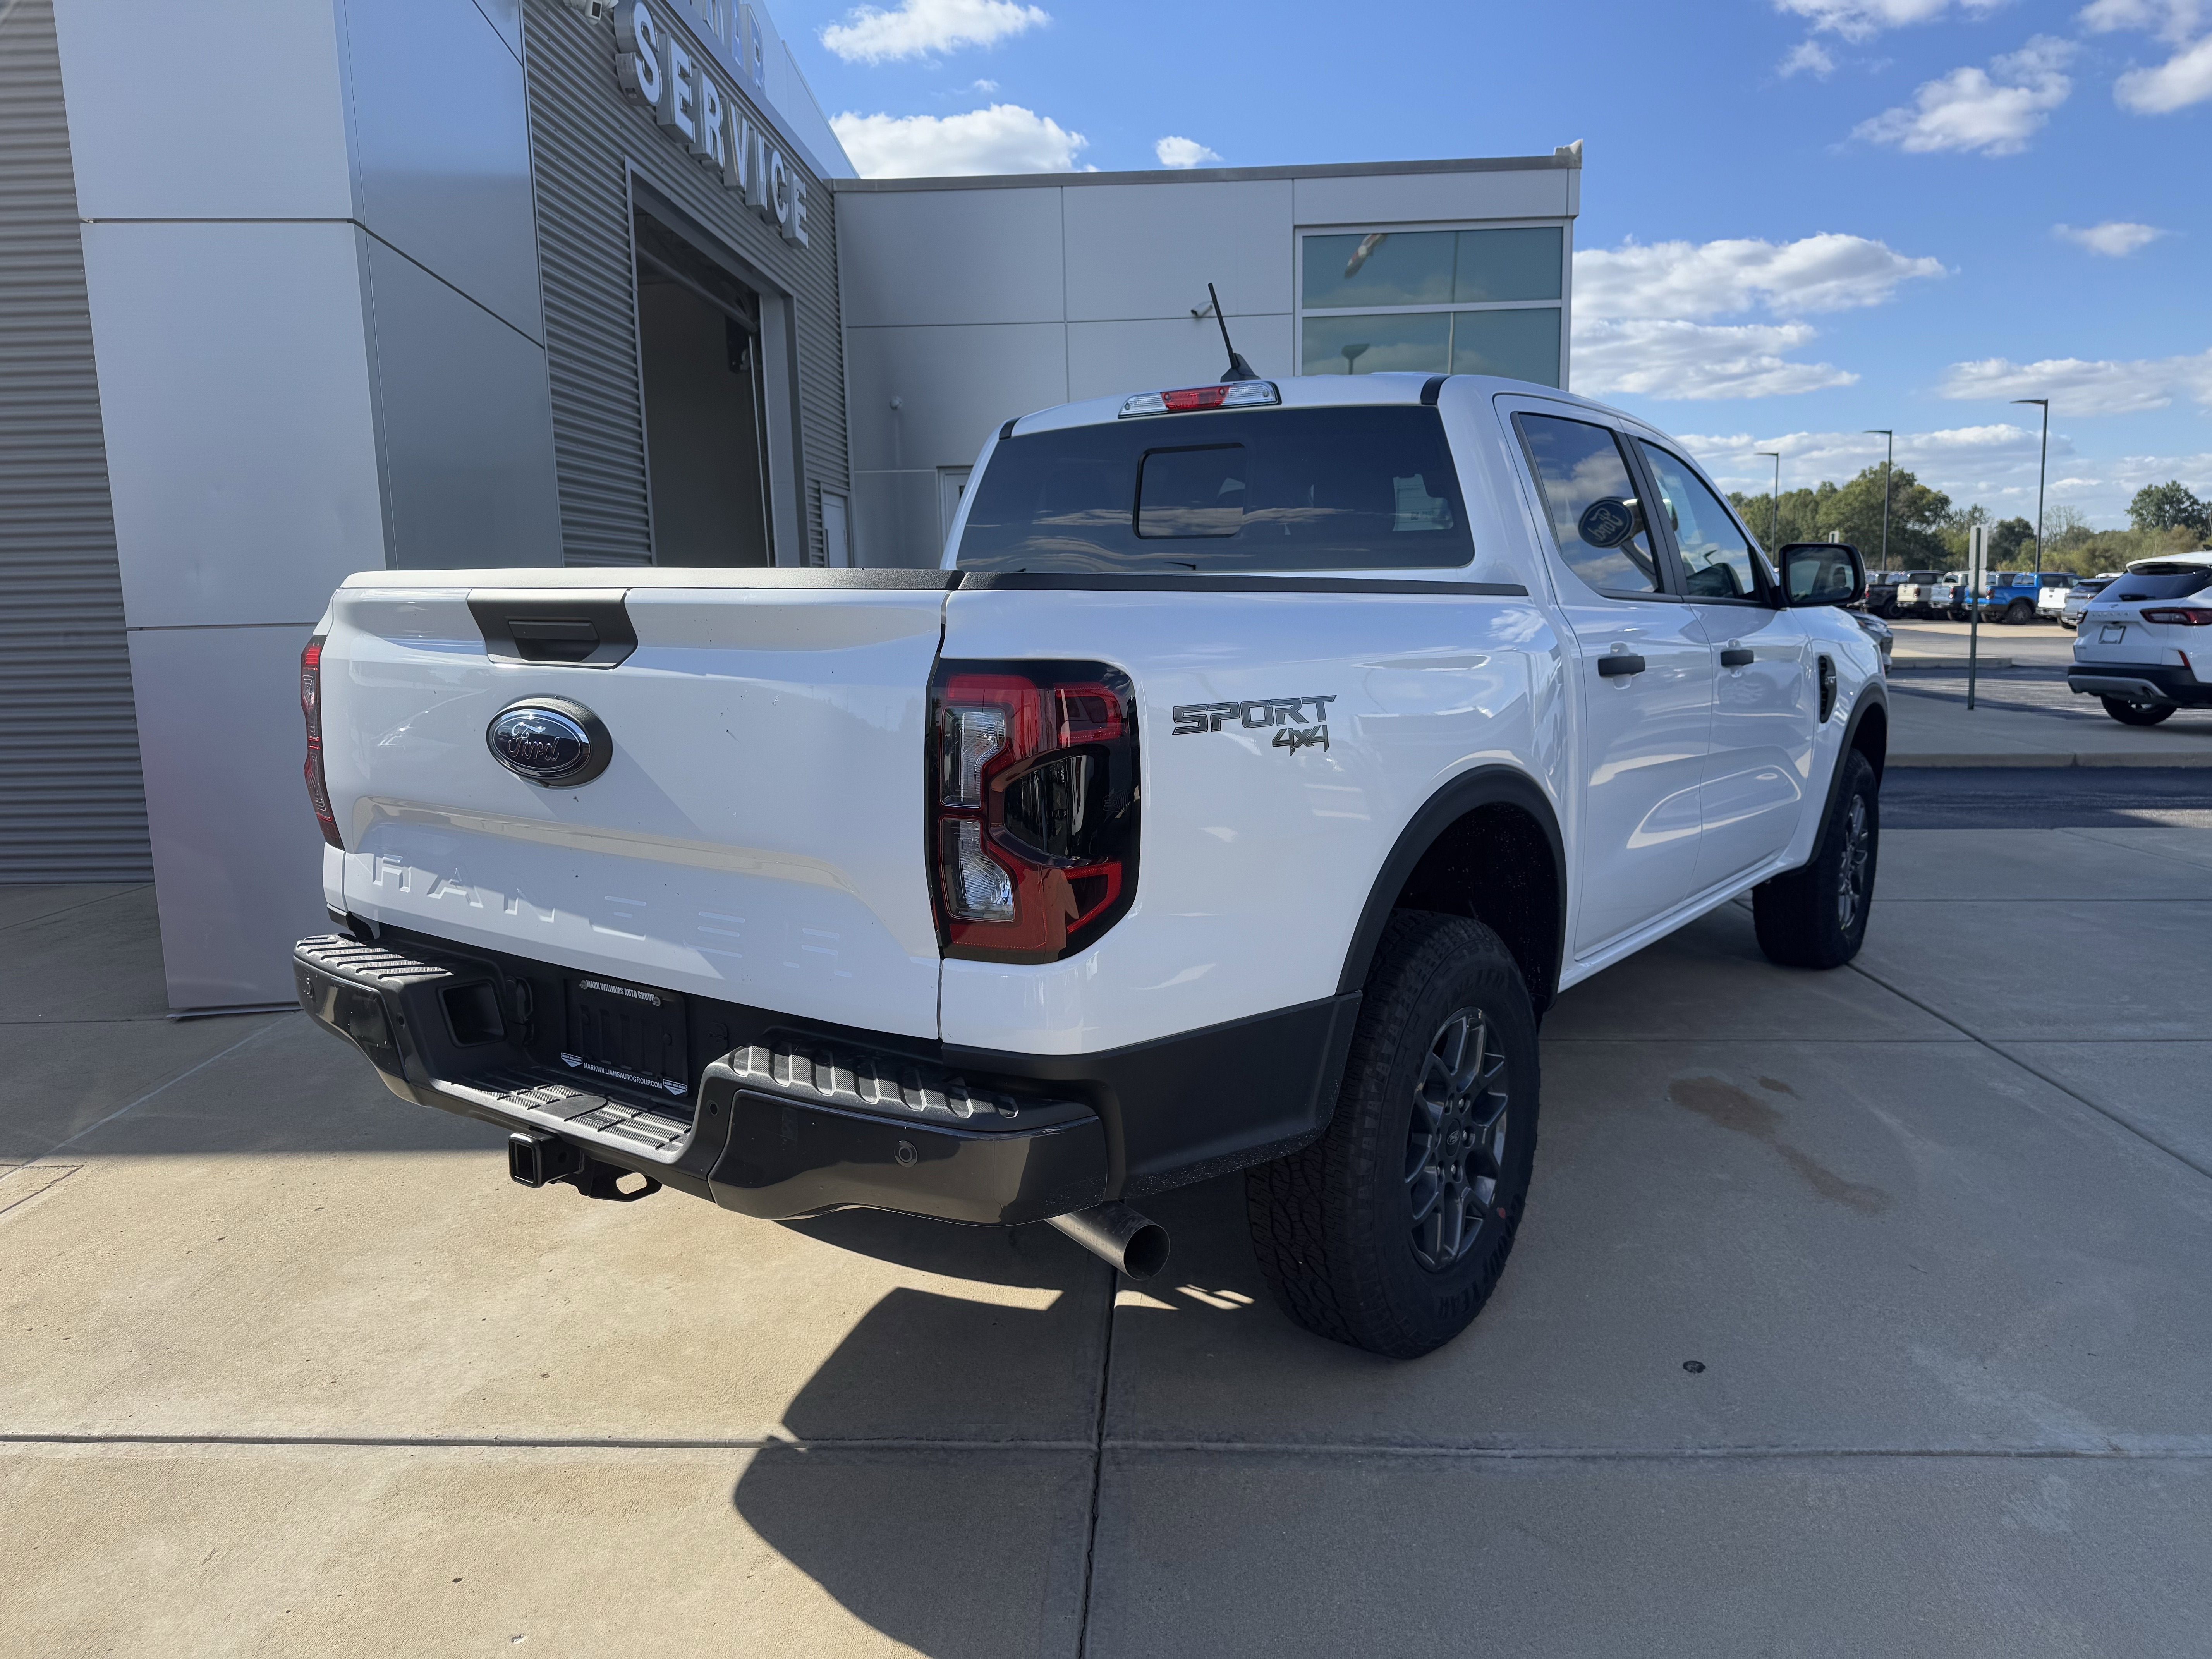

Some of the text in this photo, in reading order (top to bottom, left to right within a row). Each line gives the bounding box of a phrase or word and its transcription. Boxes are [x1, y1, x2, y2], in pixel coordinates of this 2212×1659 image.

[617, 1, 808, 250] SERVICE
[1172, 695, 1337, 735] SPORT
[507, 721, 560, 762] Ford
[586, 980, 654, 1001] MARK WILLIAMS AUTO GROUP
[584, 1062, 662, 1089] MARKWILLIAMSAUTOGROUP.COM
